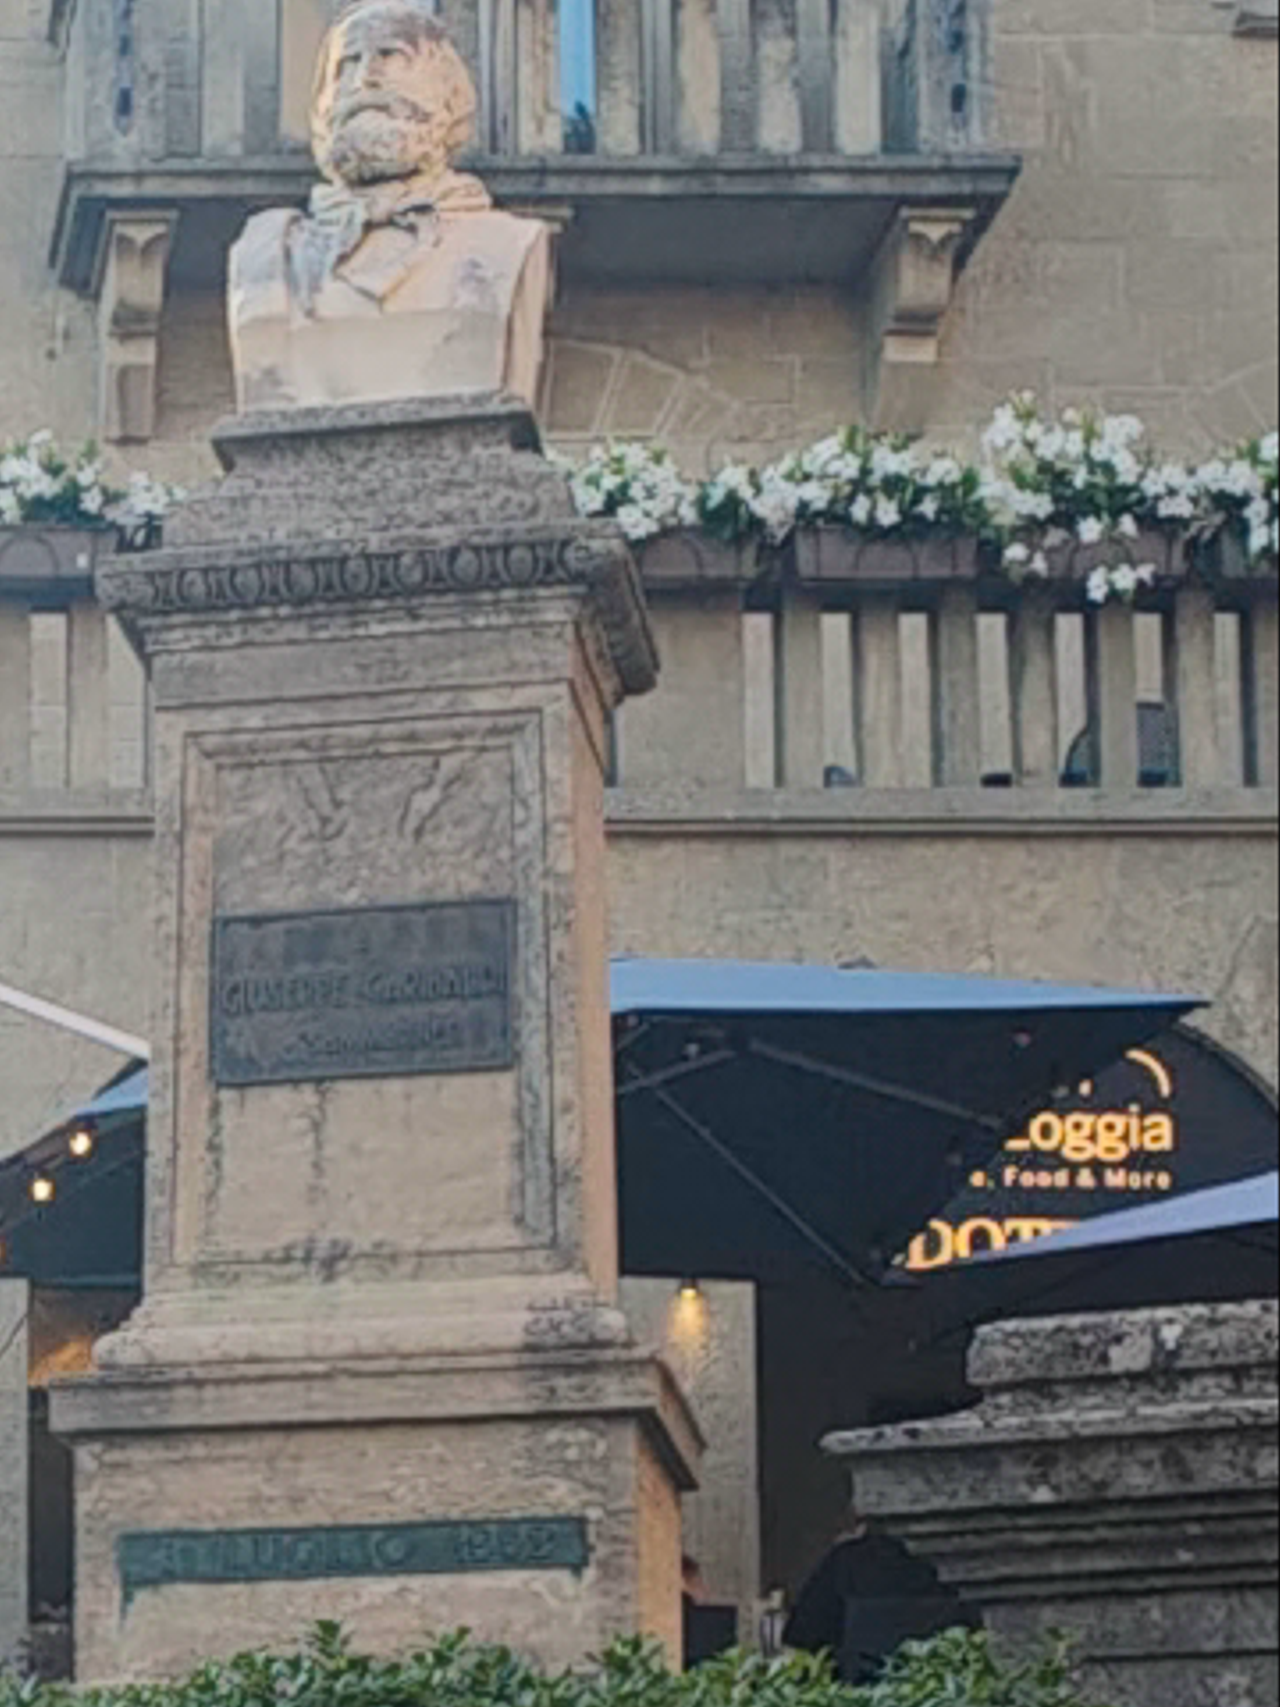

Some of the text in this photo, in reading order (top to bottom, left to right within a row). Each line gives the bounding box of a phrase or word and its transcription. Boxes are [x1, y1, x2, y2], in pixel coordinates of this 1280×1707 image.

[1004, 1103, 1173, 1162] oggia
[1003, 1166, 1070, 1187] Food
[1075, 1166, 1095, 1188] &
[1104, 1167, 1171, 1189] More
